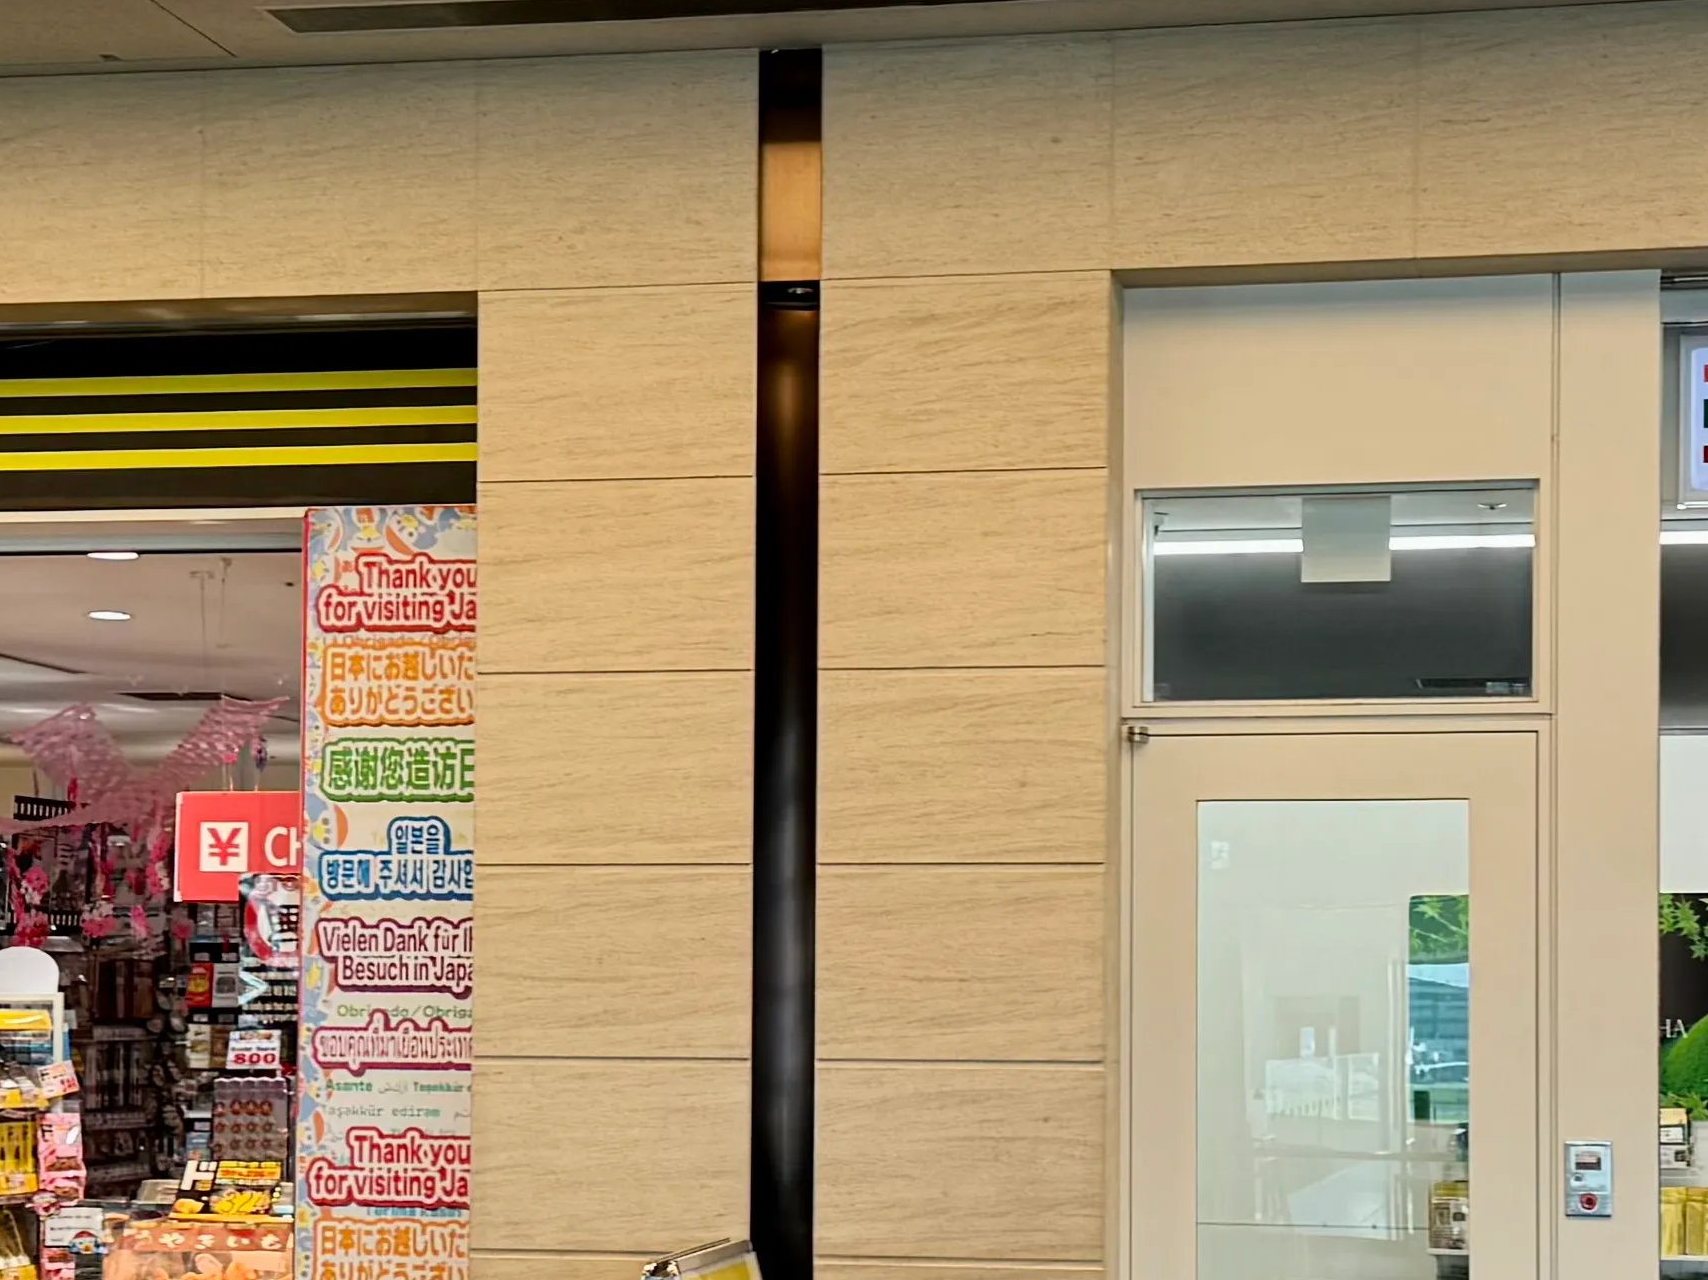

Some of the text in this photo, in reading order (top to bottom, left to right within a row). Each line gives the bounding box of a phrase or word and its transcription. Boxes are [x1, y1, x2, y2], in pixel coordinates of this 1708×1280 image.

[363, 561, 477, 592] Thank you
[324, 593, 357, 621] for
[364, 593, 445, 623] visiting
[396, 824, 440, 855] 일본을
[379, 859, 424, 889] 주셔서
[323, 925, 379, 953] Vielen
[384, 926, 429, 953] Dank
[434, 926, 459, 953] für
[343, 955, 409, 981] Besuch
[414, 956, 429, 981] in
[234, 1053, 276, 1065] 800
[354, 1135, 471, 1168] Thank you
[314, 1167, 469, 1199] for visiting Ja
